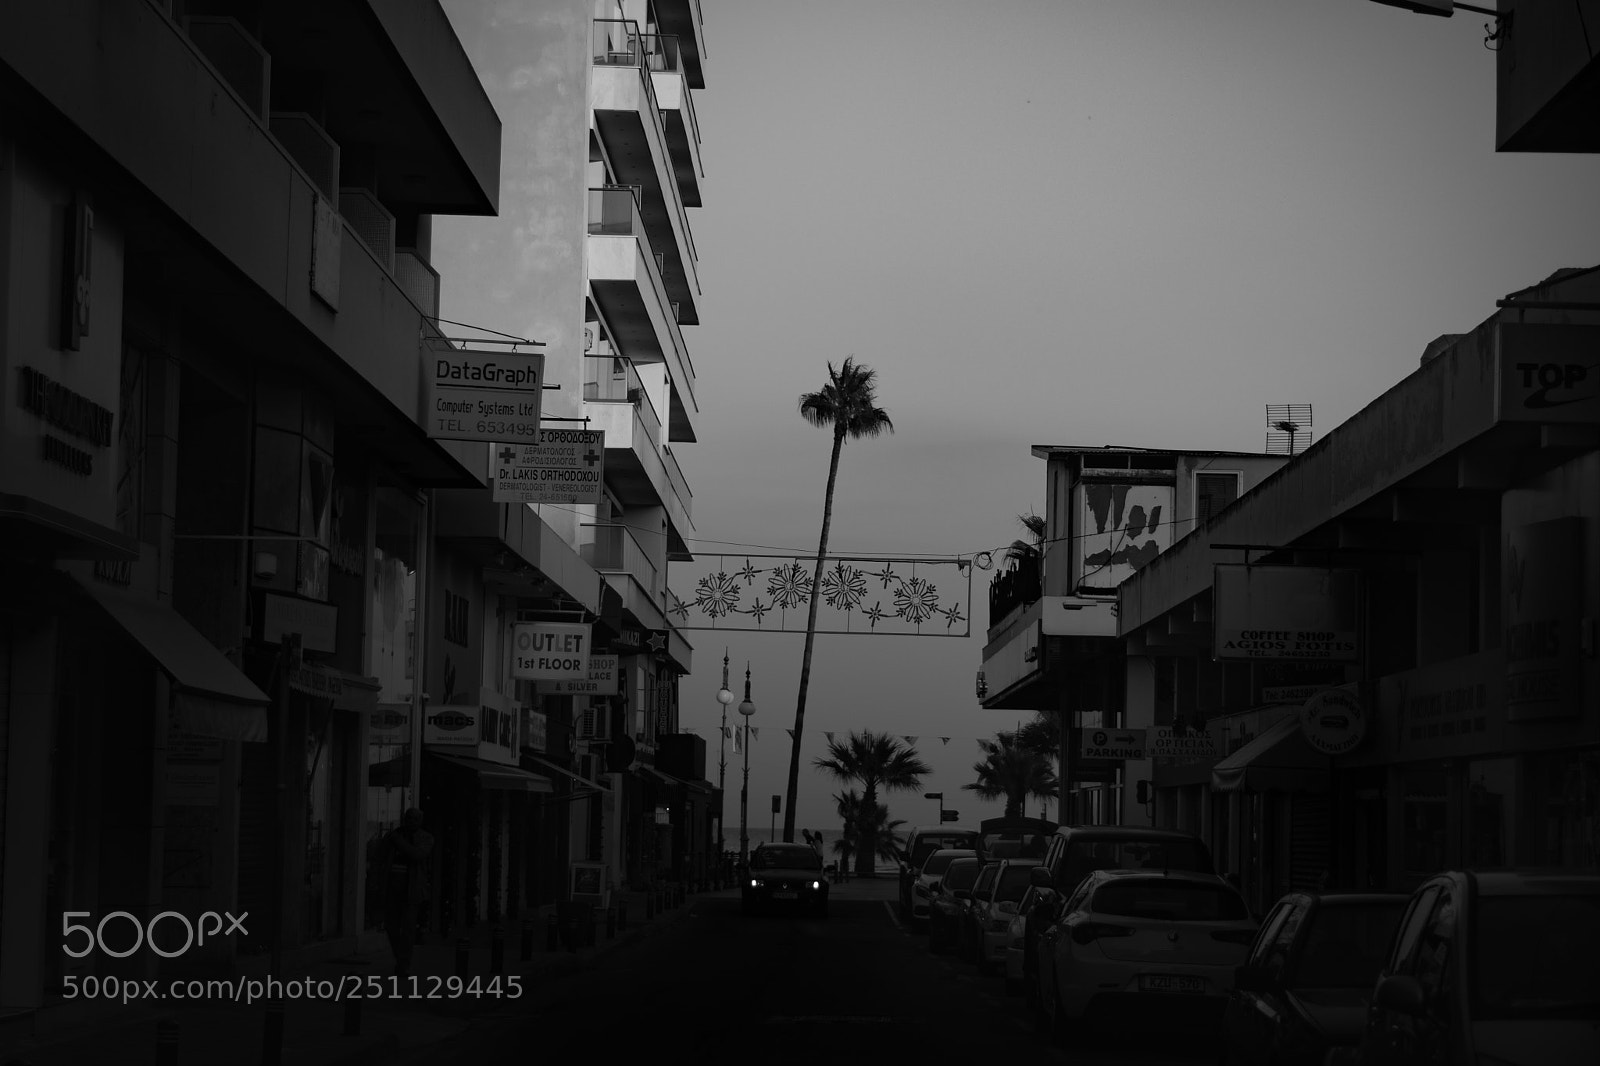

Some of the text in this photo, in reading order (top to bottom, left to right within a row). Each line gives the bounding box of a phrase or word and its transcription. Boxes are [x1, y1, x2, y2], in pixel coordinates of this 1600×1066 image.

[436, 360, 536, 386] DataGraph
[1516, 363, 1587, 389] TOP
[436, 398, 533, 417] Computer Systems Ltd
[438, 418, 535, 440] TEL. 653495
[499, 468, 599, 482] Dr. LAKIS ORTHODOXOU
[499, 482, 546, 492] DERMATOLOGIST
[551, 483, 598, 493] VENEREOLOGIST
[1241, 630, 1335, 642] COFFEE SHOP
[518, 632, 583, 653] OUTLET
[1223, 641, 1355, 652] AGIOS FOTIS
[518, 657, 581, 671] 1st FLOOR
[589, 672, 611, 681] LACE
[568, 682, 598, 691] SILVER
[427, 714, 475, 727] macs
[1158, 729, 1212, 739] ΟΠΙΚΟΣ
[1155, 738, 1215, 749] OPTICIAN
[1086, 748, 1142, 759] PARKING
